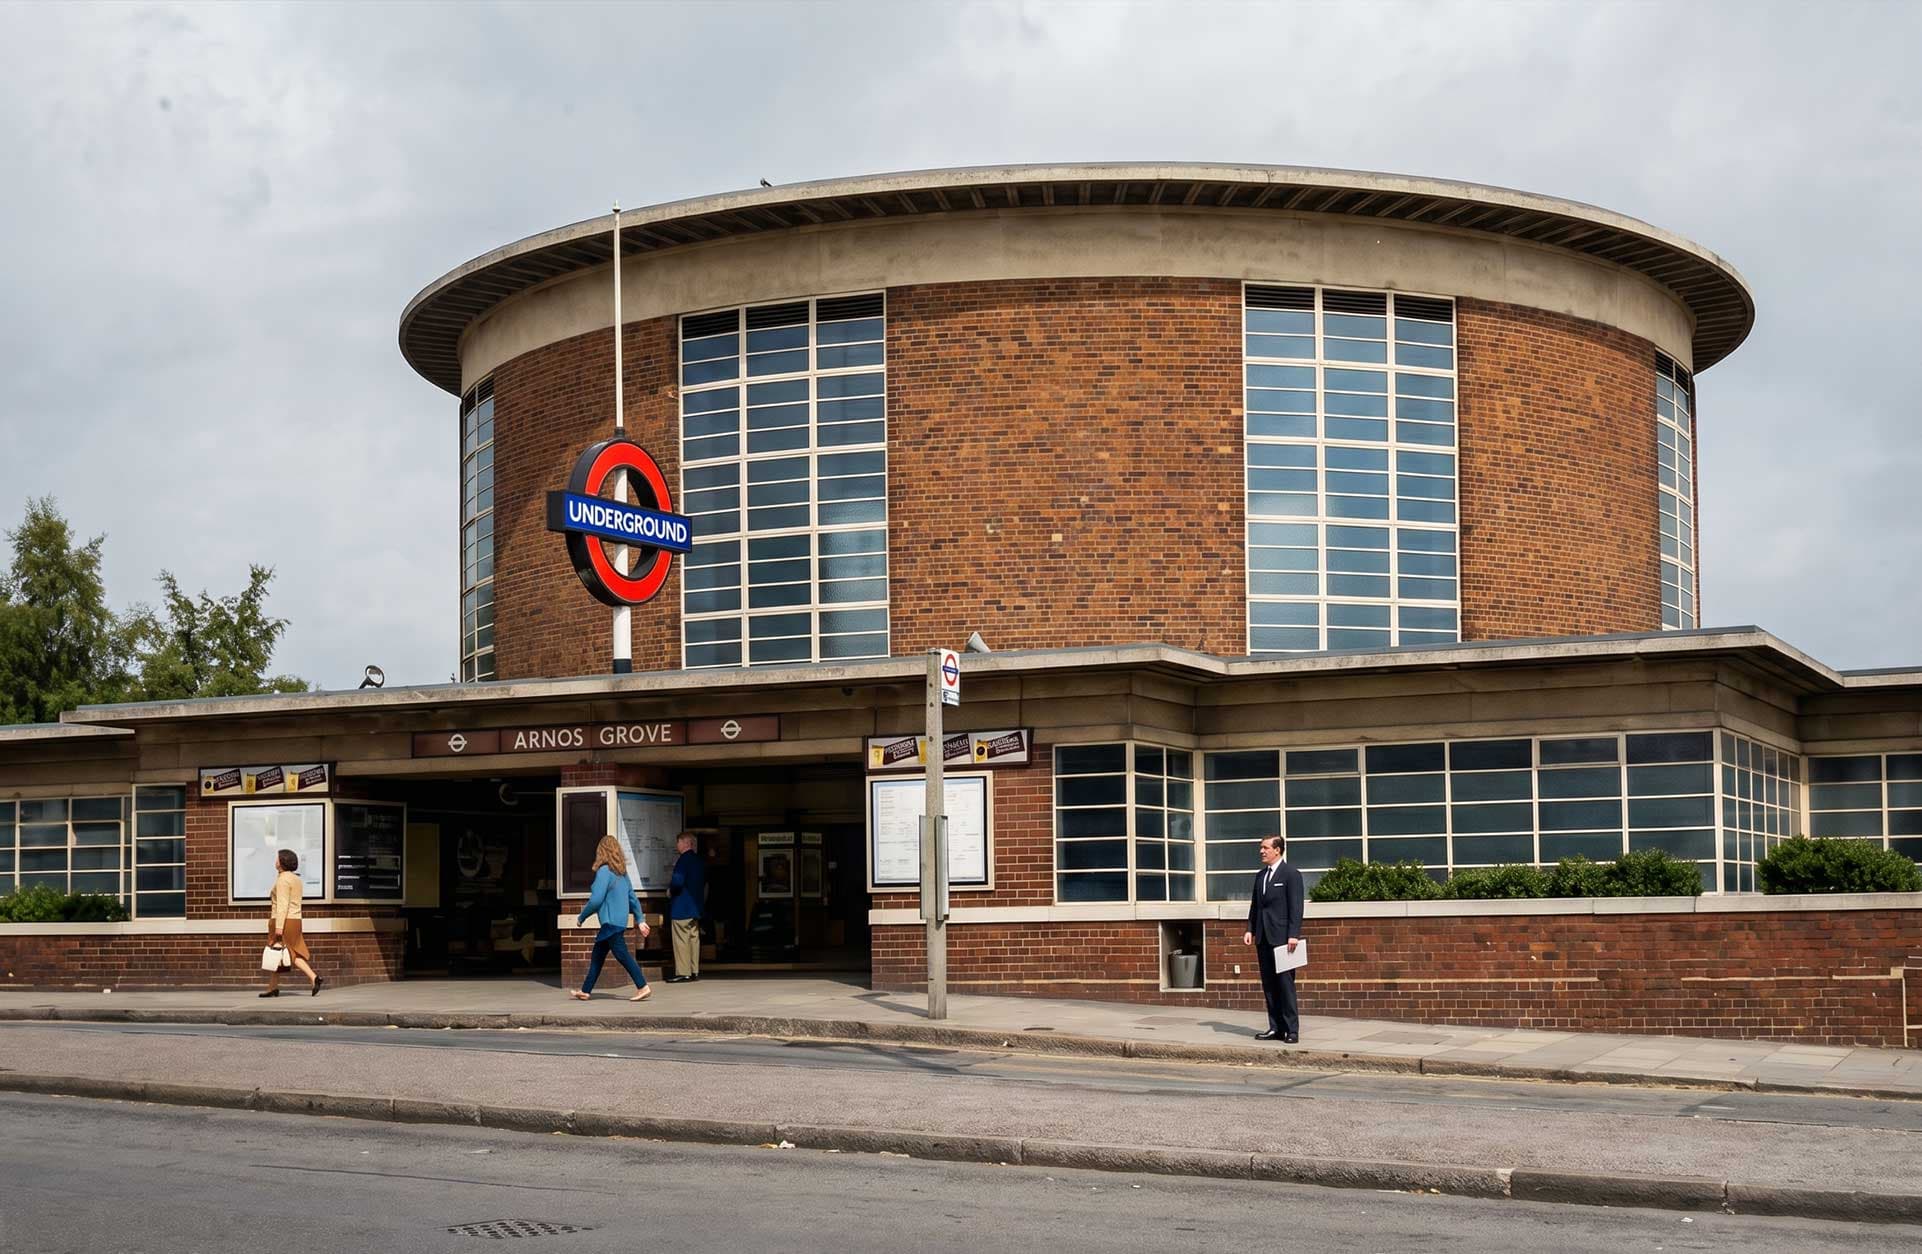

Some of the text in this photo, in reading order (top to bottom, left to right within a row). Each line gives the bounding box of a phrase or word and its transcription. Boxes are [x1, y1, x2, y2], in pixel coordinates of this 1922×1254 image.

[569, 499, 687, 543] UNDERGROUND
[514, 724, 672, 750] ARNOS GROVE
